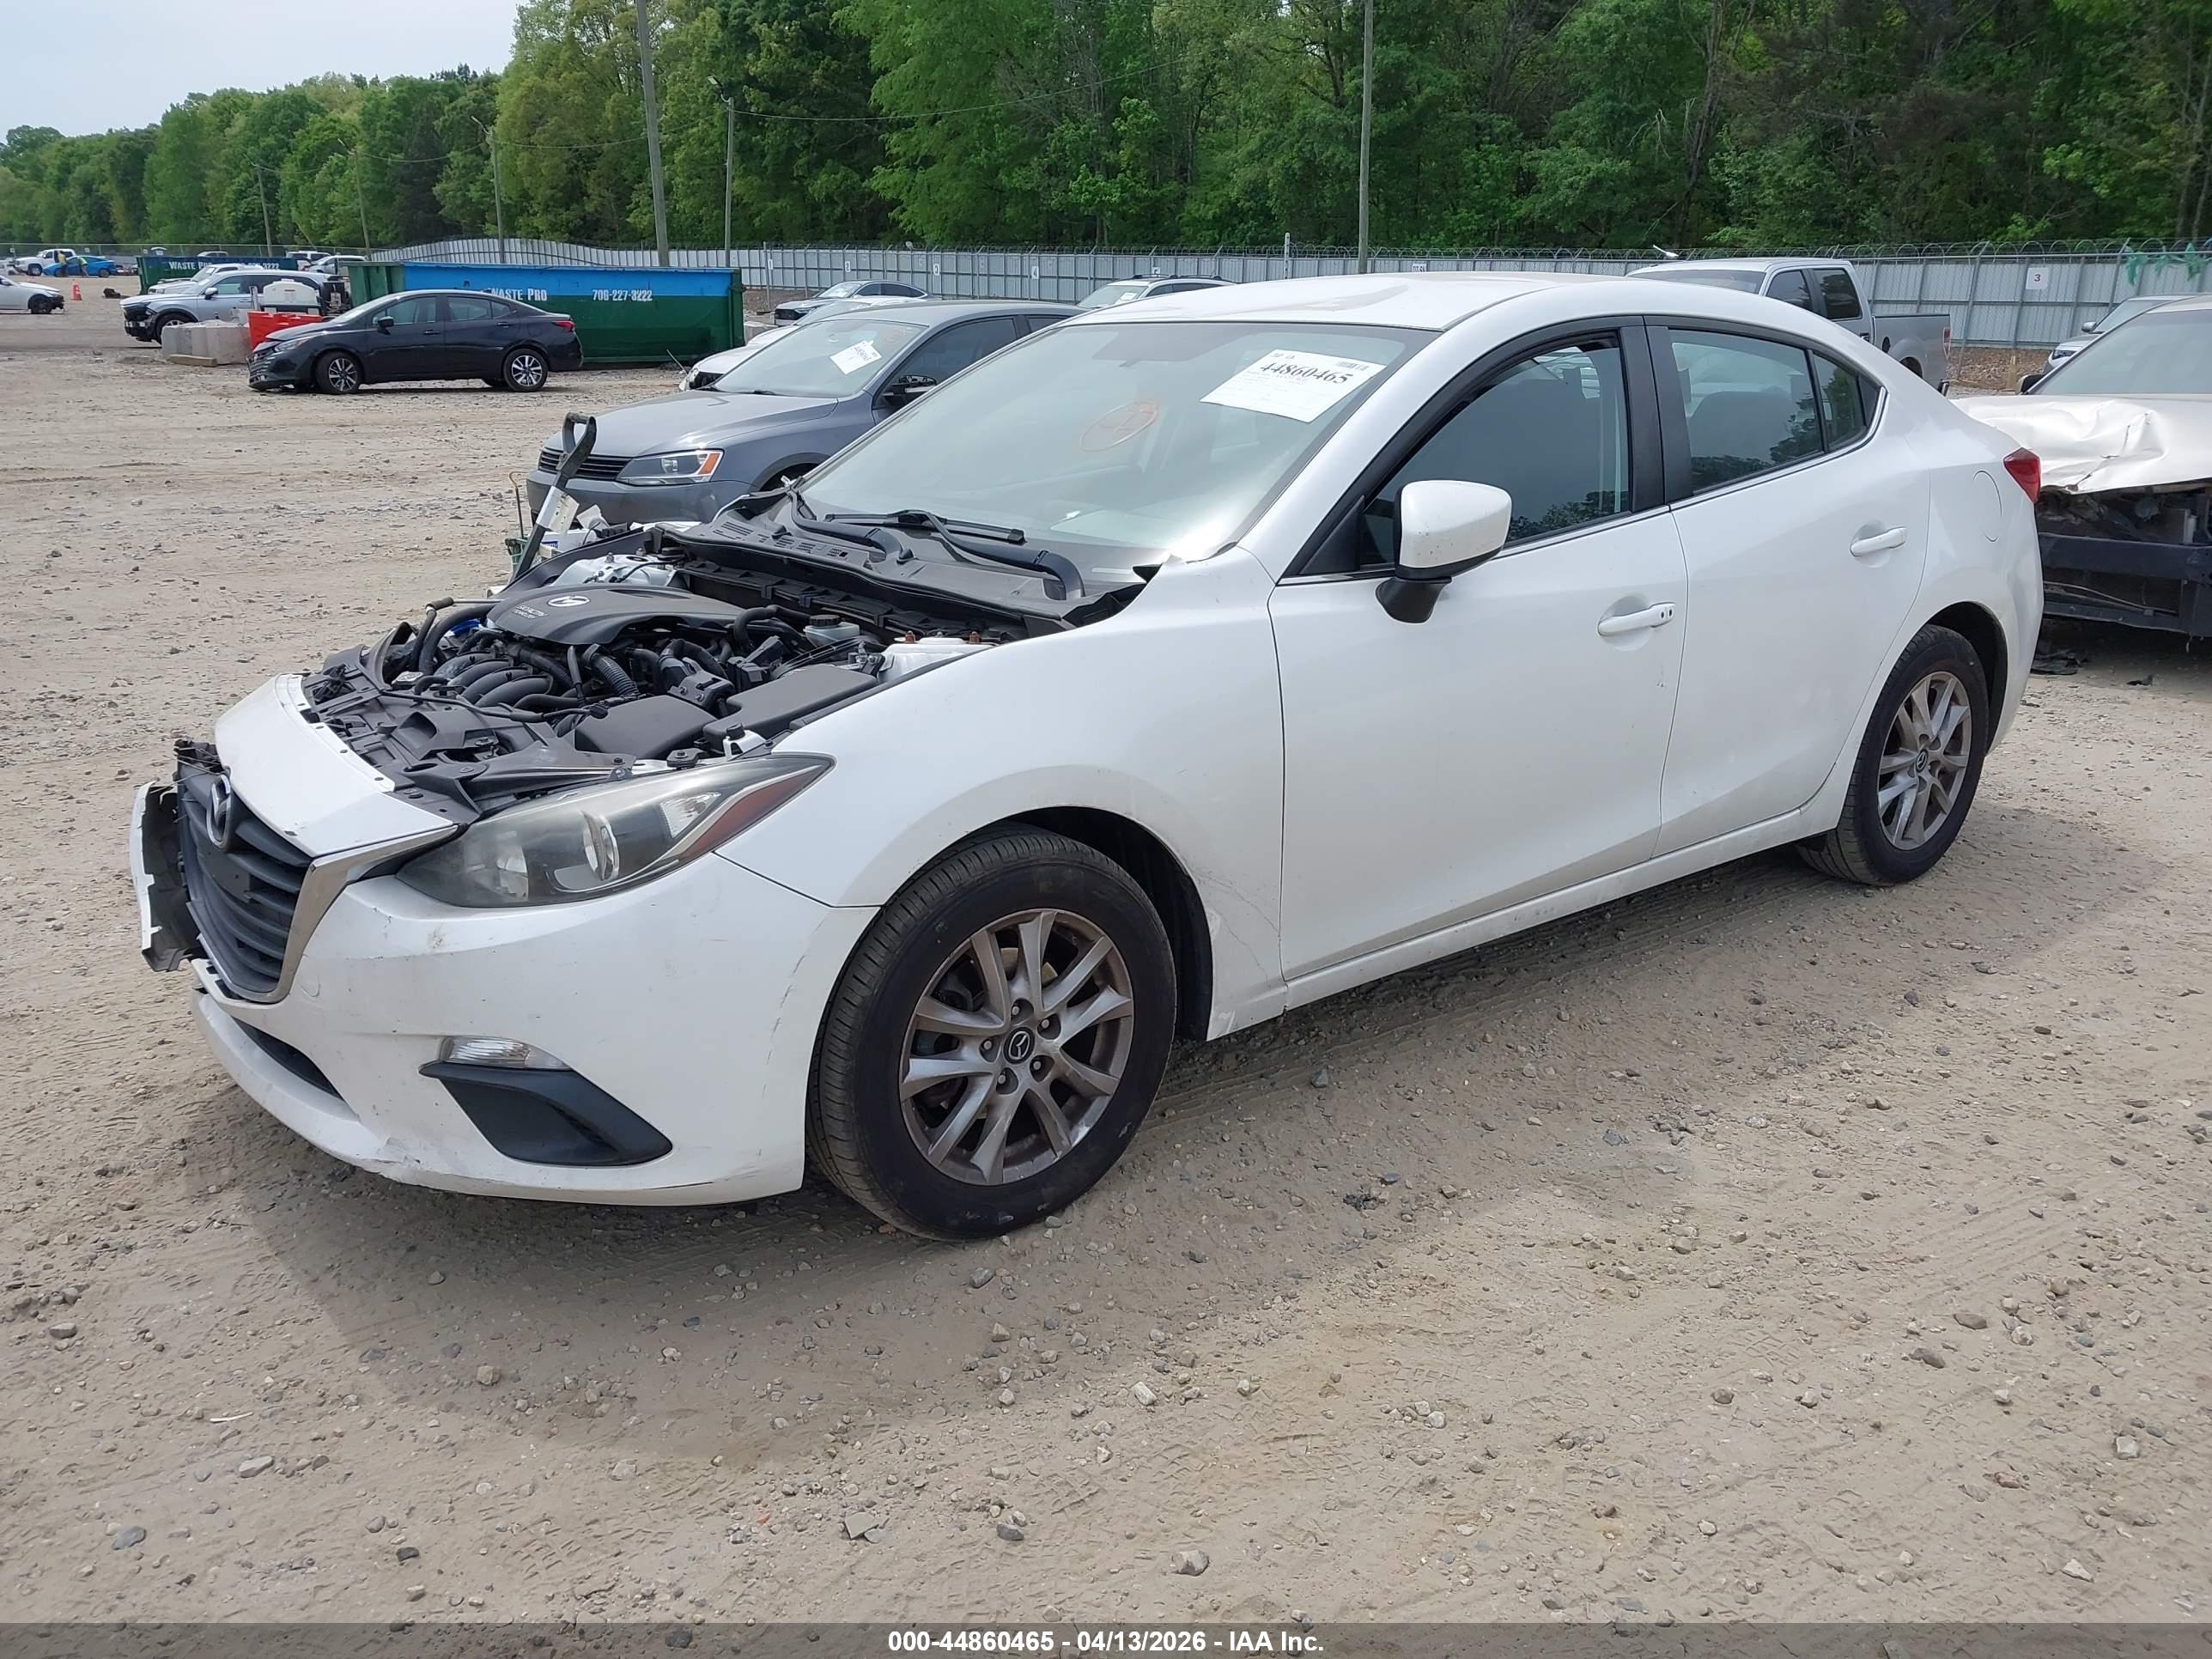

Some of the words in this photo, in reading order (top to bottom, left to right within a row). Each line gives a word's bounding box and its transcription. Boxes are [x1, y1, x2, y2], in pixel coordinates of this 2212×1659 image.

[168, 261, 196, 270] WASTE
[2033, 273, 2041, 282] 3
[527, 288, 548, 301] PRO
[592, 289, 653, 301] 706-227-3222
[1260, 362, 1354, 385] 44860465
